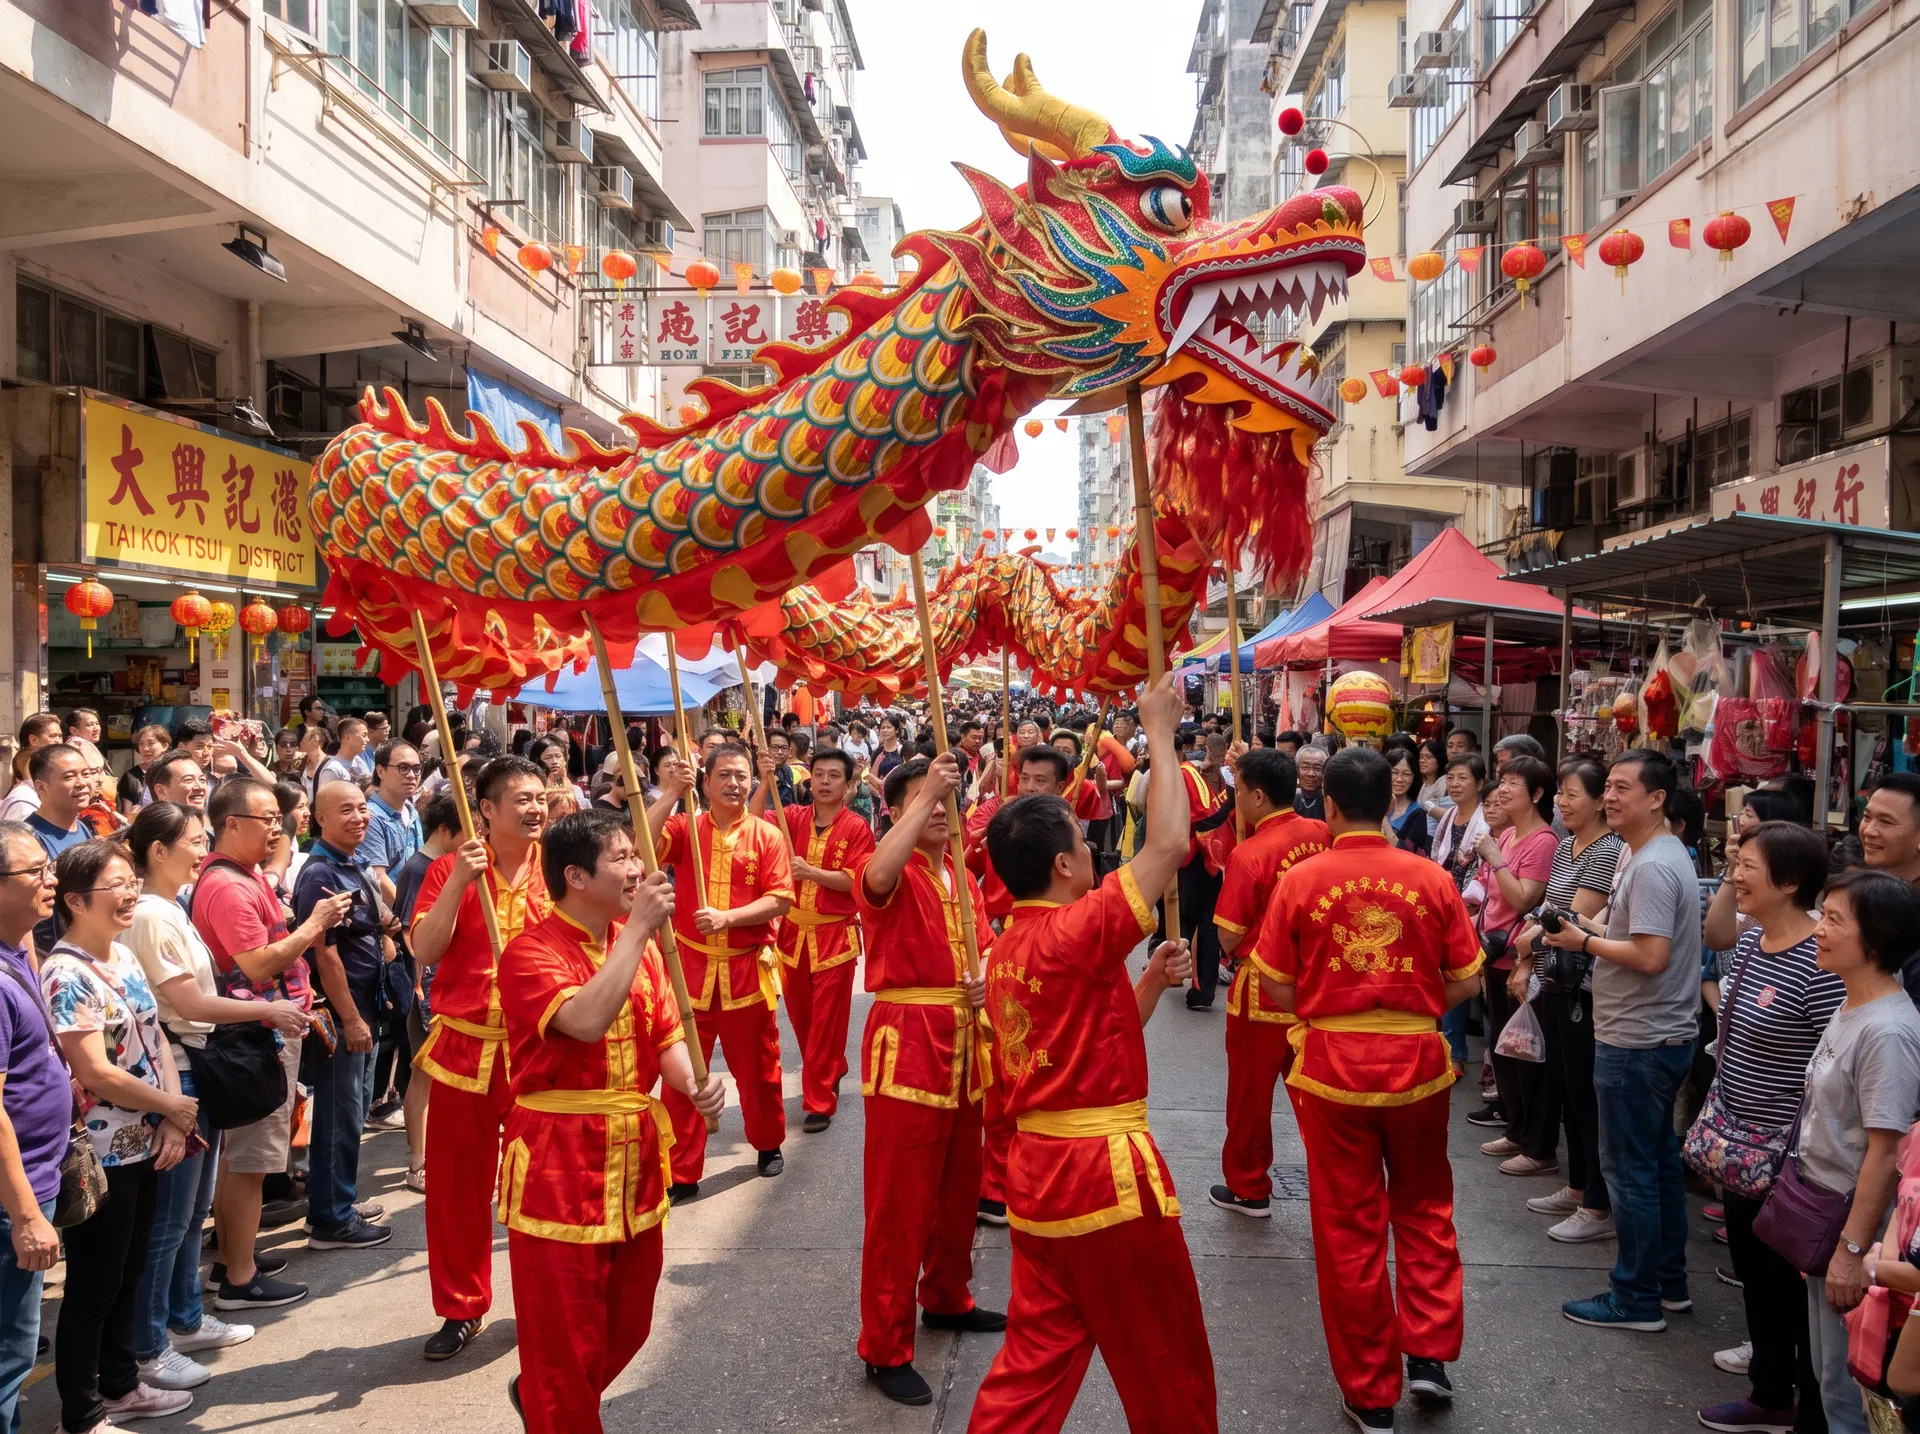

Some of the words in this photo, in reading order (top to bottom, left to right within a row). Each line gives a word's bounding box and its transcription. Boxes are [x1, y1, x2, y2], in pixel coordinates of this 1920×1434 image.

[105, 521, 136, 549] TAI
[141, 527, 180, 556] KOK
[184, 534, 223, 562] TSUI
[238, 544, 304, 573] DISTRICT
